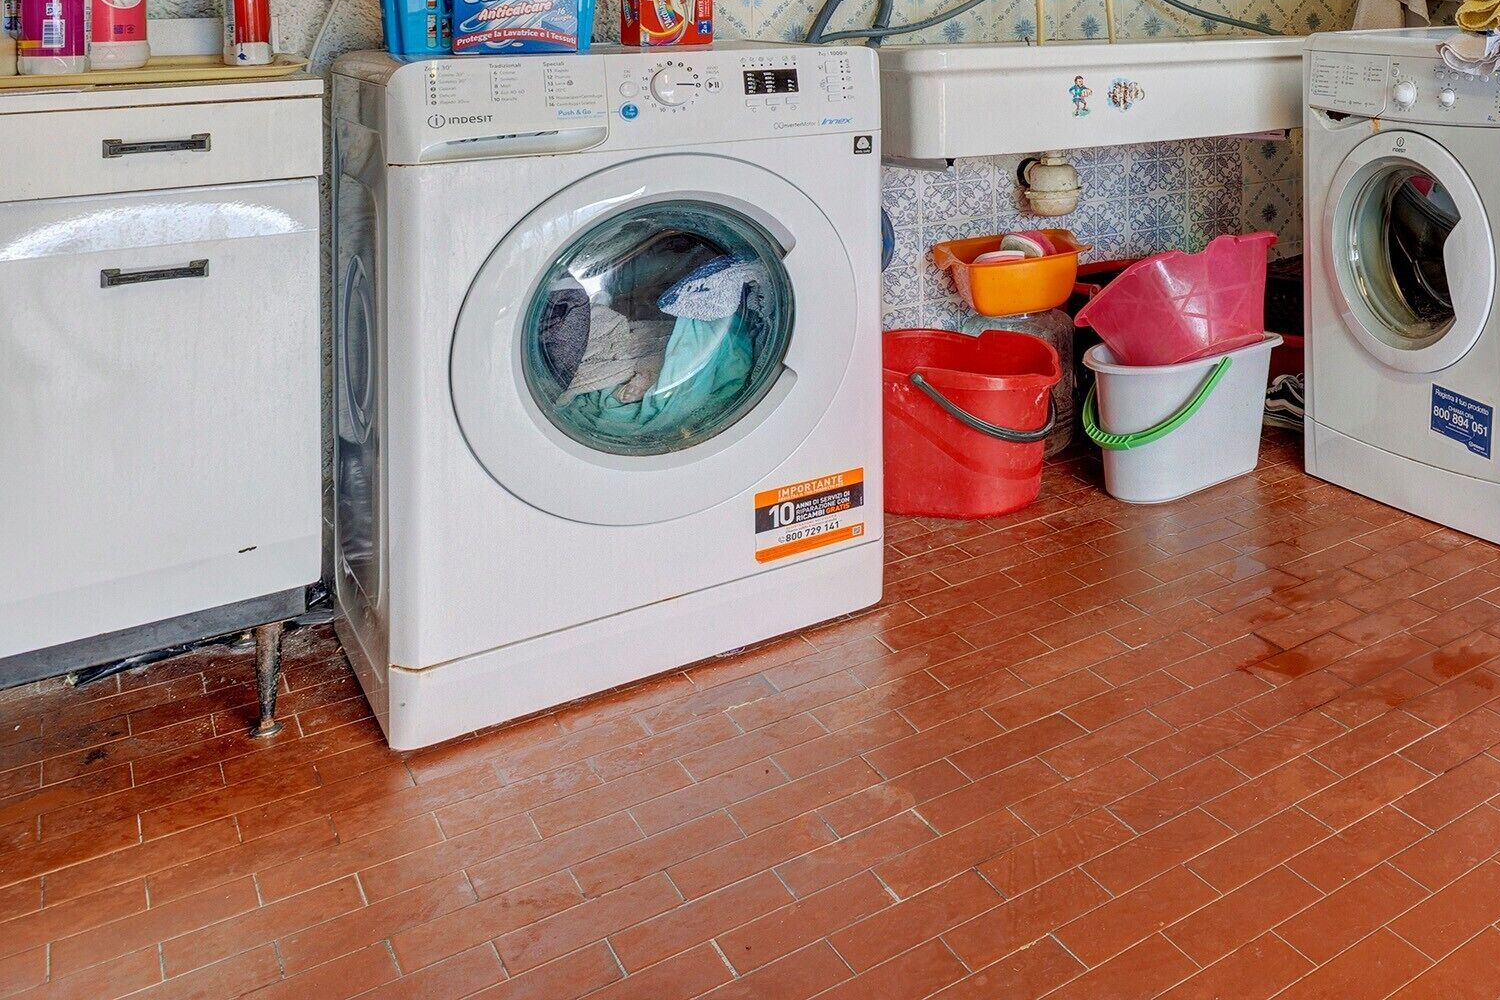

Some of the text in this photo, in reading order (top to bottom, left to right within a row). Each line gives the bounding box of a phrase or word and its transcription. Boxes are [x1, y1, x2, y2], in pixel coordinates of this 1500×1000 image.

[478, 0, 553, 22] Anticalcare
[556, 7, 566, 15] 16
[456, 33, 494, 47] Protegge
[493, 30, 503, 38] la
[503, 28, 539, 38] Lavatrice
[550, 32, 577, 45] Tessuti
[1459, 398, 1468, 407] tuo
[1468, 402, 1489, 416] prodotto
[1433, 405, 1450, 421] 800
[1452, 413, 1469, 429] 894
[1471, 421, 1488, 437] 051
[778, 475, 844, 498] IMPORTANTE
[796, 501, 812, 510] ANNI
[820, 492, 843, 504] SERVIZI
[796, 496, 851, 516] RIPARAZIONE CON
[768, 501, 795, 529] 10
[796, 508, 826, 522] RICAMBI
[785, 532, 803, 543] 800
[805, 526, 821, 538] 729
[825, 521, 840, 532] 141
